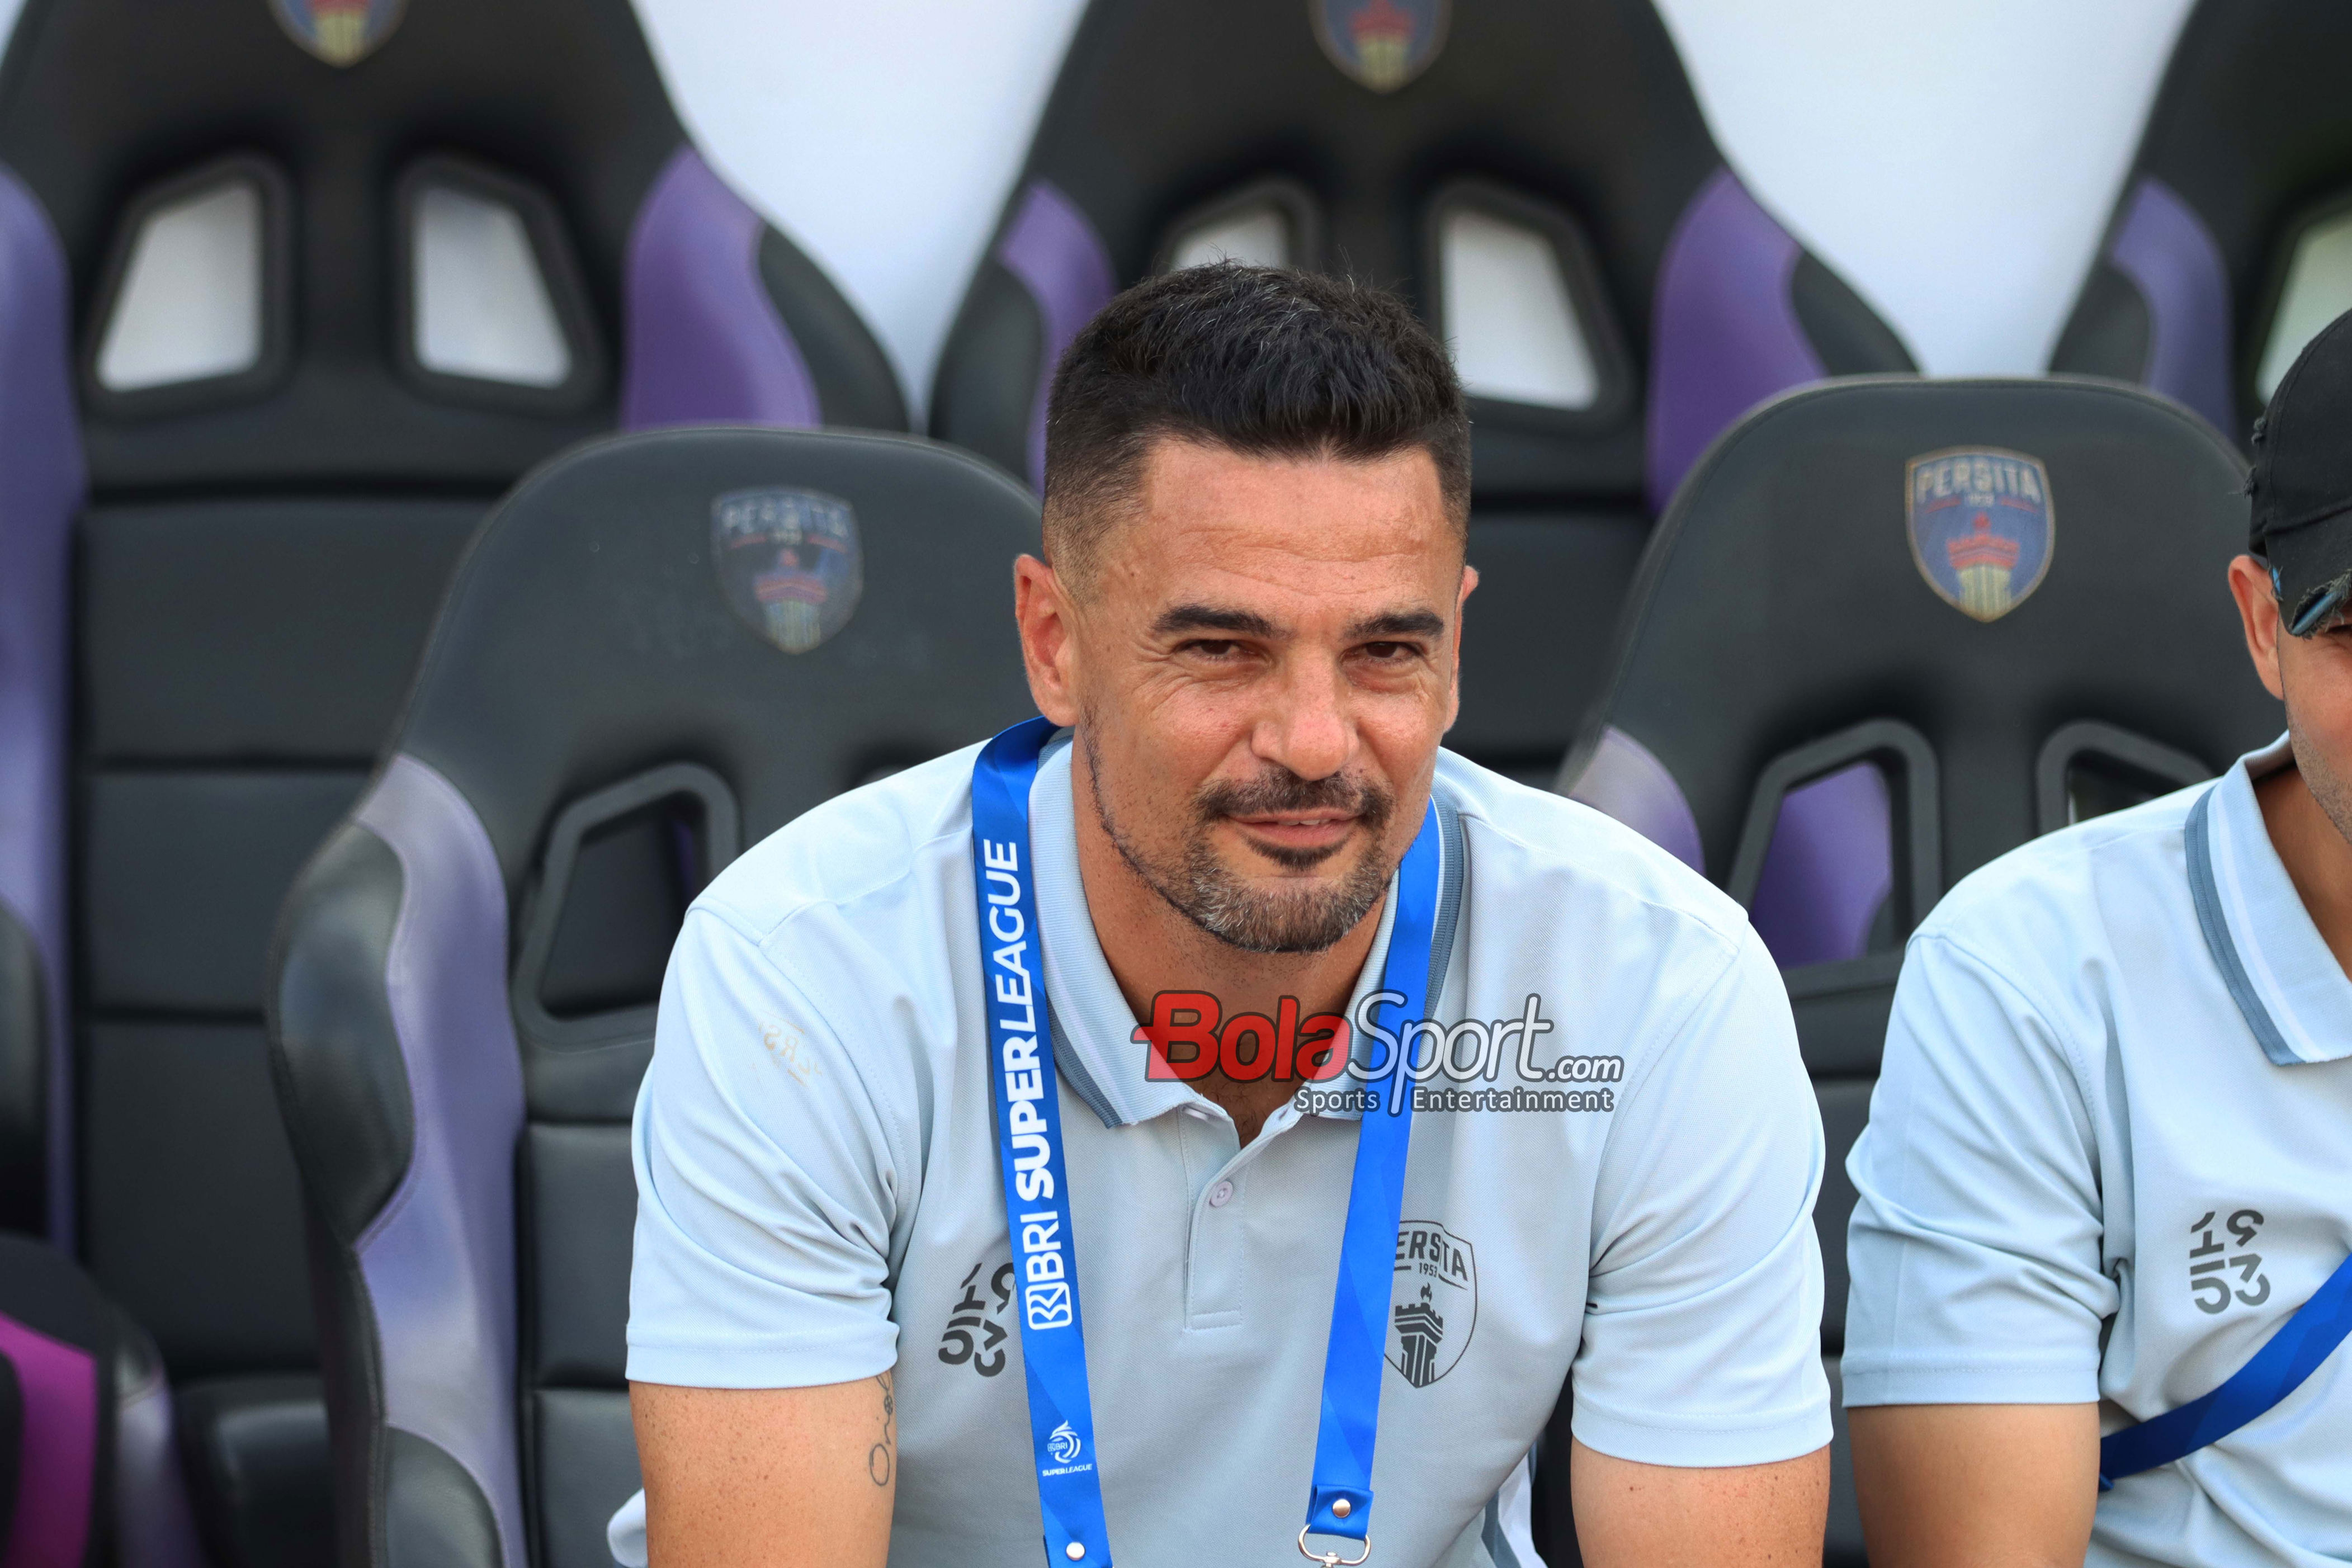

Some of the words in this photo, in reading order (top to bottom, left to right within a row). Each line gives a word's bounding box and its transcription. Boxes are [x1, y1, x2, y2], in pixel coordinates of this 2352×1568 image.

[1915, 456, 2042, 504] PERSITA
[1019, 1211, 1065, 1283] BRI
[1419, 1262, 1438, 1278] 1953
[1055, 1442, 1068, 1451] BRI
